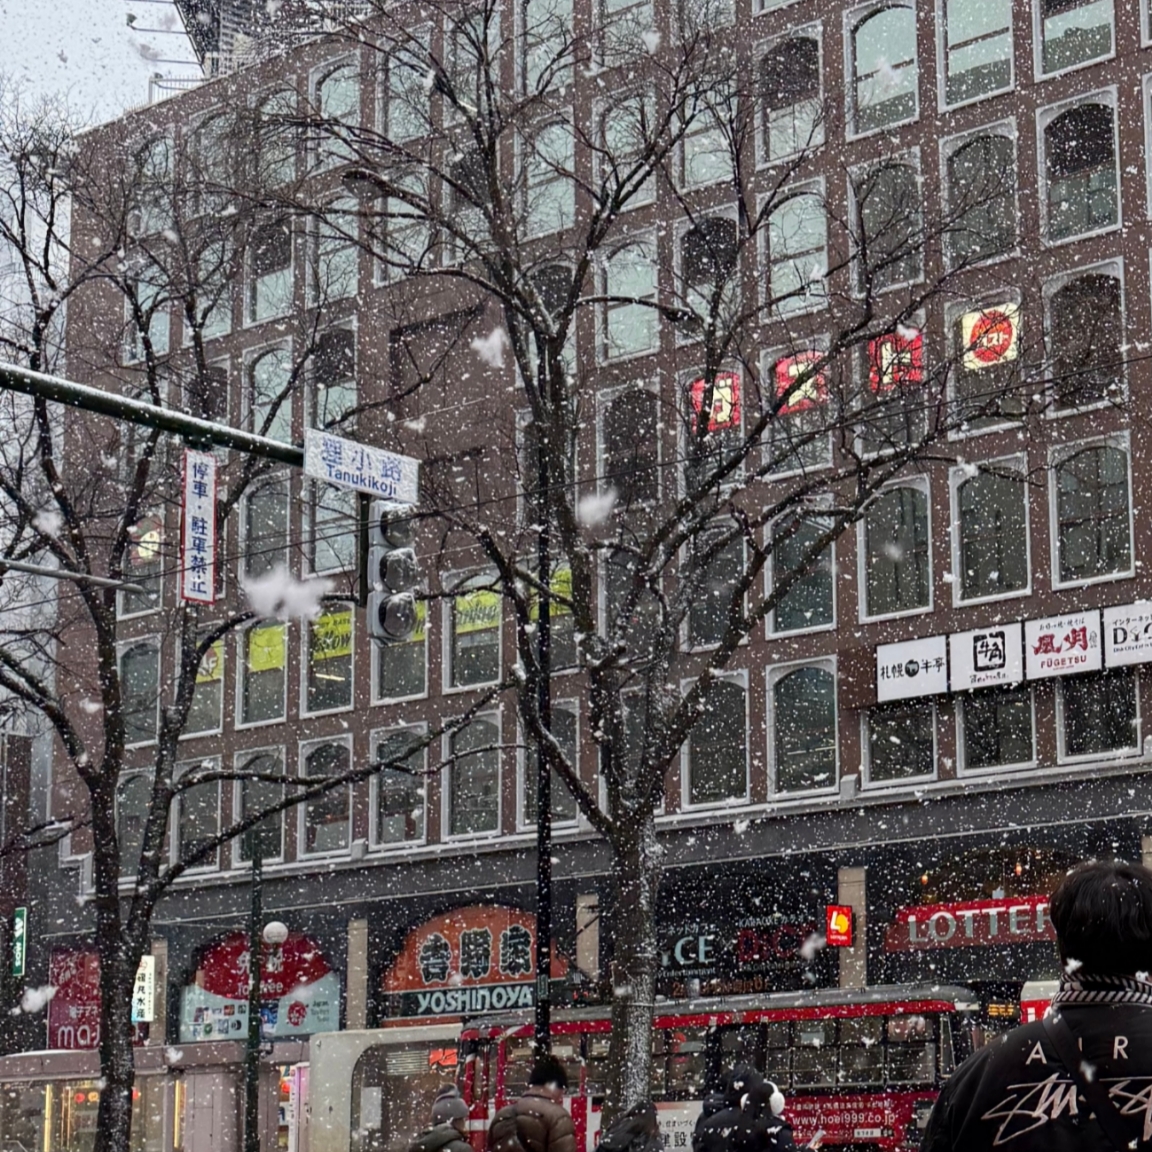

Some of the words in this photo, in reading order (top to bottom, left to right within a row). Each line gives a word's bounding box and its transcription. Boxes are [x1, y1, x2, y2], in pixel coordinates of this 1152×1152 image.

[326, 462, 397, 496] Tanukikoji
[1033, 626, 1089, 655] 風月
[908, 903, 1051, 943] LOTTER
[417, 985, 533, 1013] YOSHINOYA
